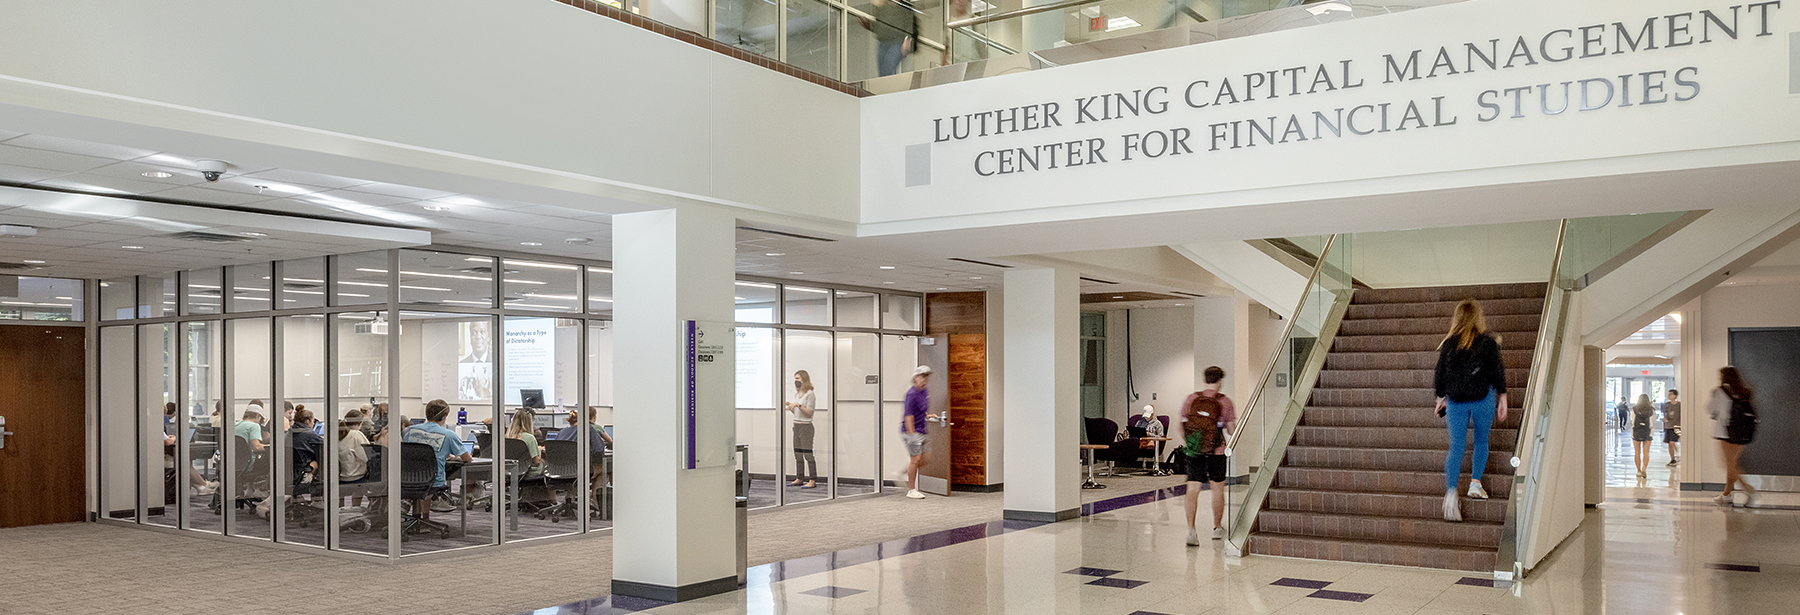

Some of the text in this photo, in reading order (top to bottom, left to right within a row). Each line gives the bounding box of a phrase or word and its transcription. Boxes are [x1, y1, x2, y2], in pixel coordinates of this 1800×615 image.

[933, 1, 1781, 143] LUTHER KING CAPITAL MANAGEMENT
[1091, 16, 1105, 30] EXIT
[974, 67, 1701, 177] CENTER FOR FINANCIAL STUDIES
